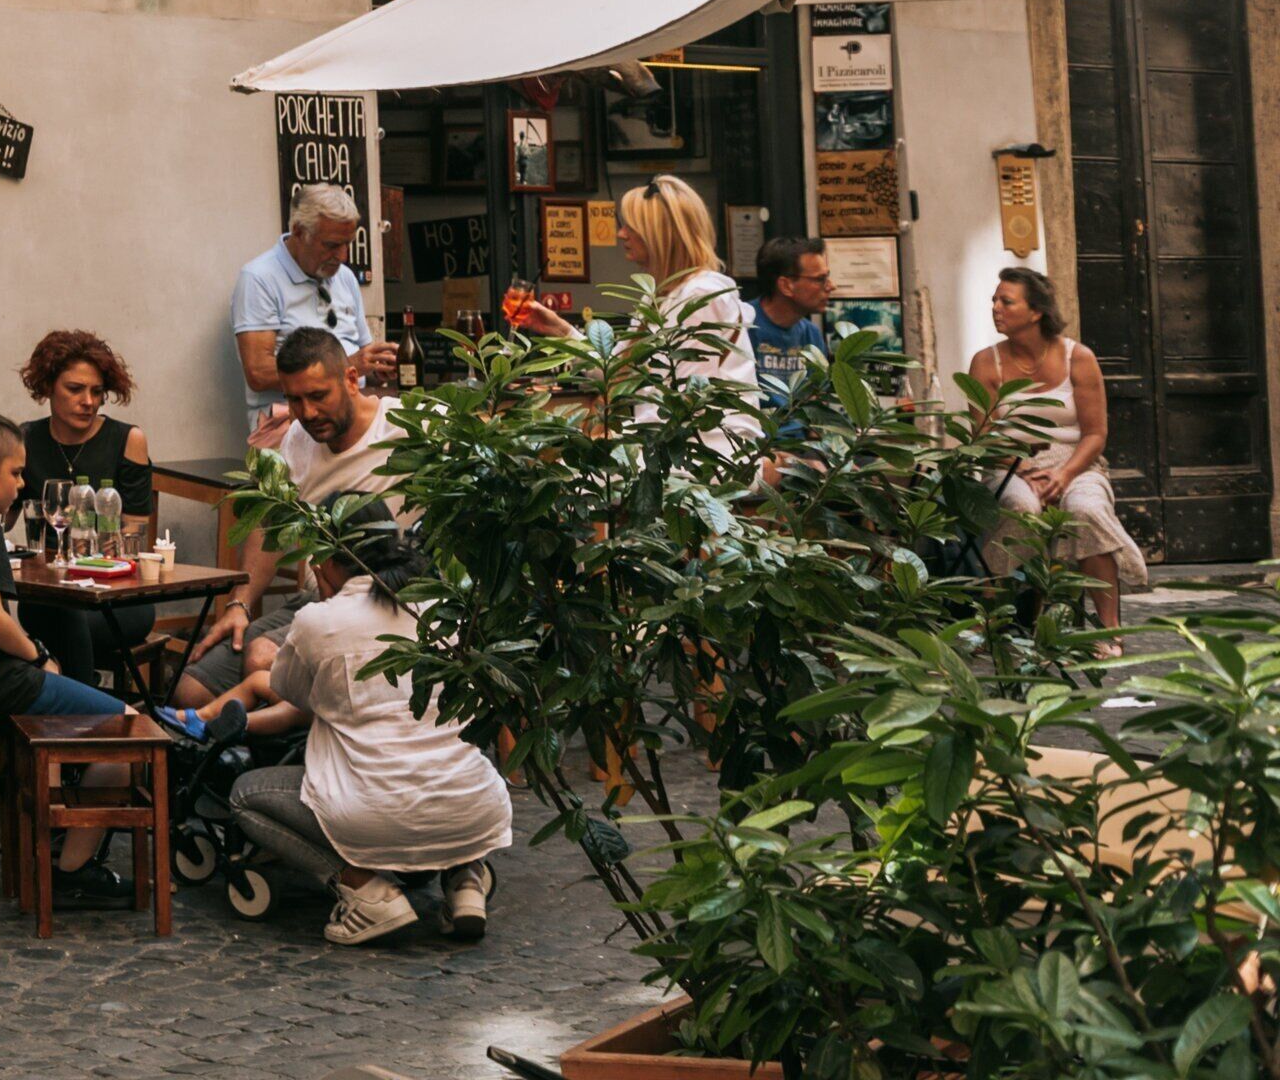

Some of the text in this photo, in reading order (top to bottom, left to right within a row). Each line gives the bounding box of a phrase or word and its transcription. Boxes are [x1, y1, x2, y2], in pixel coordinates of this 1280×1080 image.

[827, 64, 886, 77] Pizzicaroli
[278, 95, 366, 138] PORCHETTA
[294, 141, 350, 183] CALDA
[424, 222, 453, 248] HO
